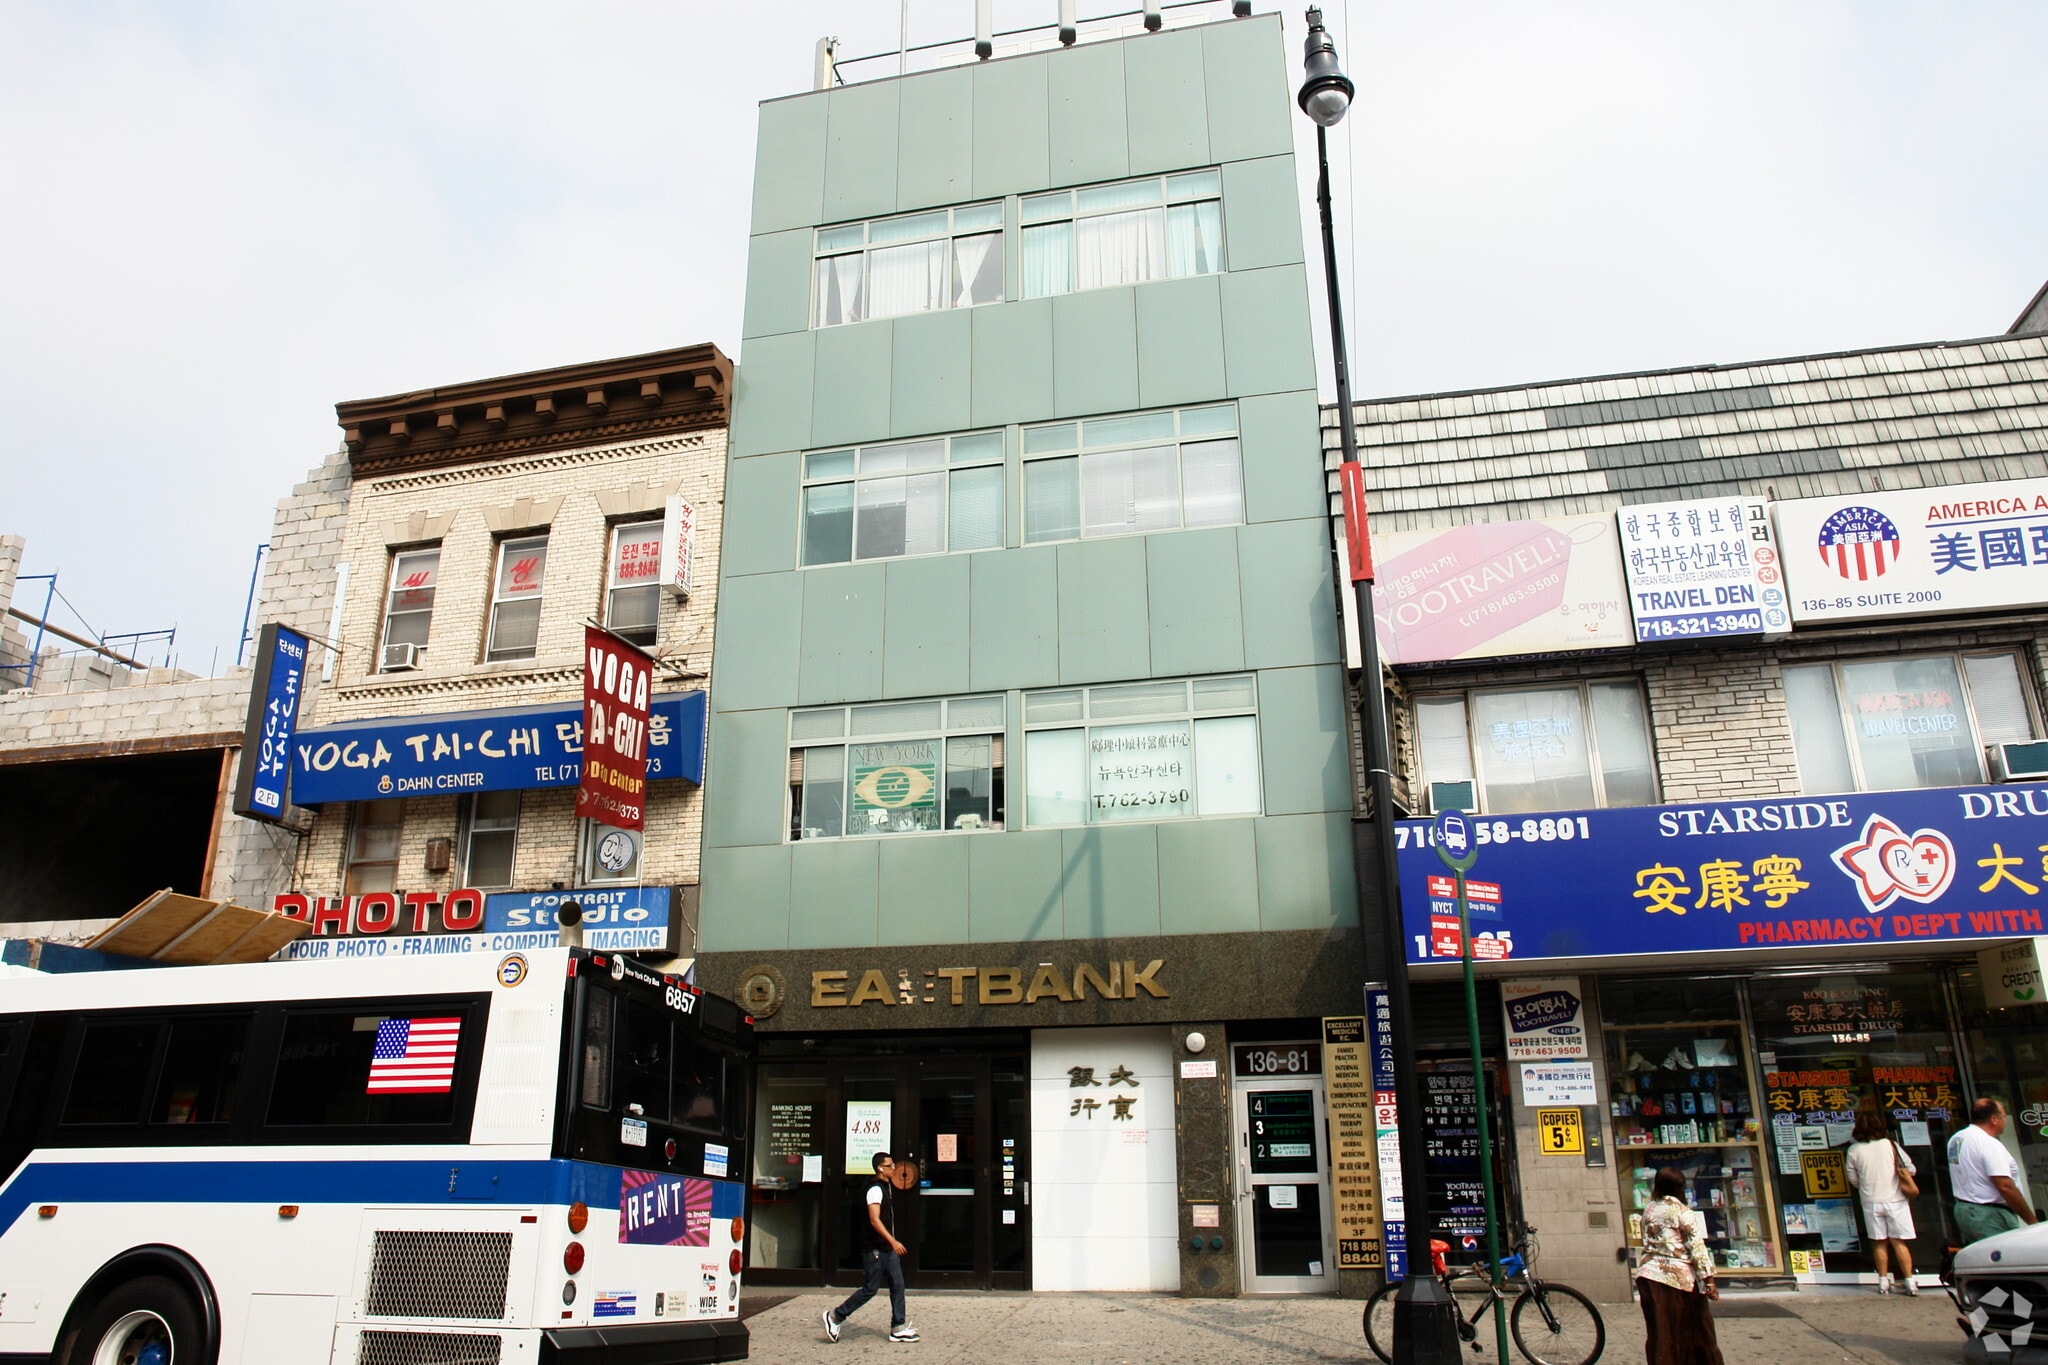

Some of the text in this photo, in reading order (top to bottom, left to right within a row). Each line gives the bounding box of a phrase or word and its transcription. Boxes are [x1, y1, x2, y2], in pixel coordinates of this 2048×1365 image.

[1927, 497, 2027, 521] AMERICA
[1747, 504, 1769, 541] 고려
[1831, 510, 1883, 533] AMERICA
[1844, 522, 1869, 531] ASIA
[1832, 530, 1884, 545] 美國亞洲
[622, 541, 659, 560] 운전 학교
[1631, 539, 1750, 575] 한국부동산교육원
[1375, 536, 1561, 634] YOOTRAVEL!
[1633, 567, 1751, 586] KOREAN REAL ESTATE LEARNING CENTER
[1469, 573, 1560, 625] (718)463-9500
[1637, 584, 1755, 611] TRAVEL DEN
[1801, 590, 1942, 611] 136-85 SUITE 2000
[1638, 613, 1760, 637] 718-321-3940
[279, 639, 303, 660] 단센터
[589, 646, 648, 711] YOGA
[273, 670, 299, 777] TAI-CHI
[1908, 713, 1957, 734] CENTER
[259, 698, 279, 773] YOGA
[299, 739, 392, 772] YOGA
[556, 714, 672, 753] 단흡
[855, 743, 935, 762] NEW YORK
[398, 773, 484, 791] DAHN CENTER
[535, 767, 555, 781] TEL
[258, 790, 276, 805] 2 FL
[1658, 789, 2048, 837] STARSIDE DRU
[1632, 843, 2048, 916] 安康寧 大
[531, 892, 626, 907] PORTRAIT
[1432, 901, 1453, 914] NYCT
[273, 888, 486, 936] PHOTO
[1738, 908, 2043, 944] PHARMACY DEPT WITH
[289, 929, 661, 958] HOUR PHOTO FRAMING COMPUT IMAGING
[625, 967, 634, 976] New
[634, 971, 643, 980] York
[643, 974, 651, 984] City
[811, 959, 1169, 1007] EATBANK
[2001, 970, 2040, 988] CREDIT
[666, 985, 696, 1014] 6857
[1803, 990, 1827, 1000] KOO
[1864, 988, 1888, 998] INC.
[1513, 995, 1567, 1019] 유여행사
[1786, 1001, 1907, 1022] 安康寧大藥房
[1517, 1011, 1572, 1028] YOOTRAVEL!
[1793, 1020, 1903, 1034] STARSIDE DRUGS
[1832, 1034, 1871, 1043] 136-85
[1246, 1051, 1309, 1073] 136-81
[1767, 1066, 1955, 1088] STARSIDE PHARMACY
[1330, 1091, 1367, 1099] CHIROPRACTIC
[1434, 1094, 1452, 1105] 번역
[1768, 1085, 1957, 1112] 安康寧 大藥房
[1254, 1099, 1262, 1113] 4
[1332, 1101, 1368, 1109] ACUPUNCTURE
[851, 1120, 881, 1134] 4.88
[1256, 1120, 1264, 1134] 3
[1543, 1114, 1577, 1126] COPIES
[1257, 1144, 1265, 1157] 2
[1806, 1156, 1841, 1169] COPIES
[627, 1181, 681, 1231] RENT
[1341, 1241, 1379, 1251] 718 886
[701, 1263, 719, 1272] Warning!
[1342, 1253, 1379, 1263] 8840
[699, 1296, 717, 1307] WIDE
